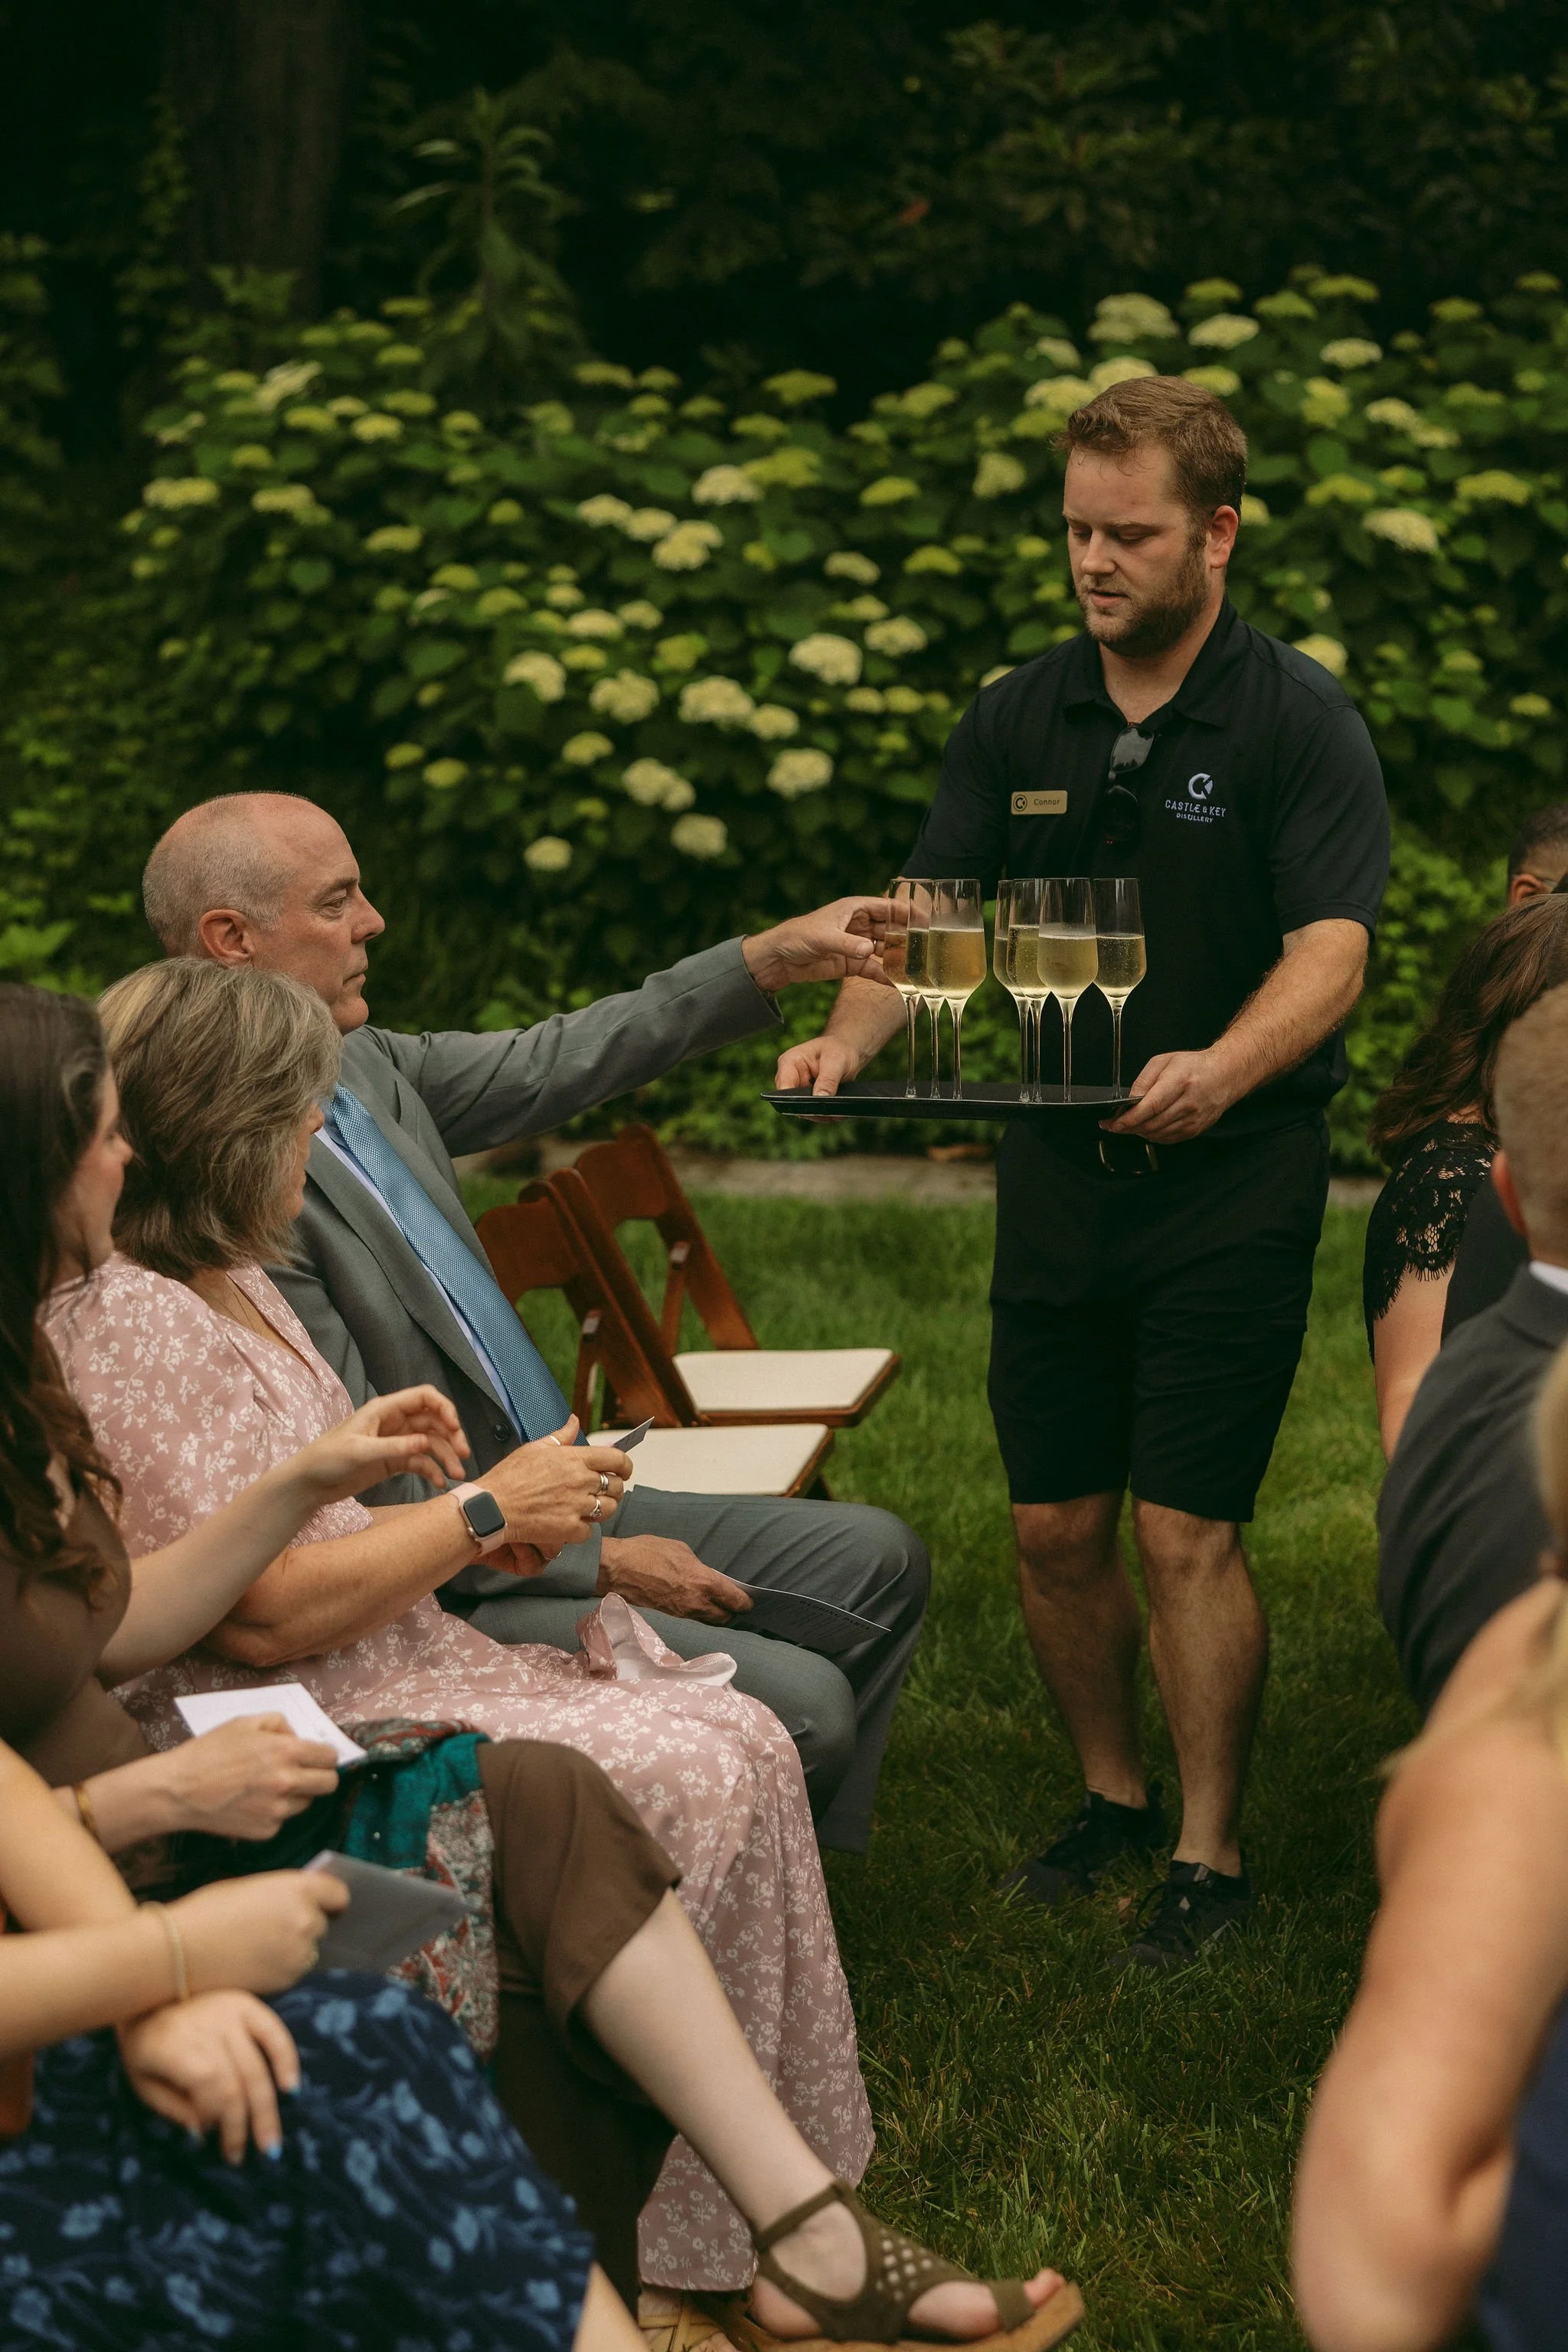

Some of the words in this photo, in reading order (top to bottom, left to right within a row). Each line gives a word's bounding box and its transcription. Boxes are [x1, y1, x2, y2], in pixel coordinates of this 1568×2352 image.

[1165, 799, 1200, 813] CASTLE
[1210, 806, 1226, 817] KEY
[1176, 813, 1214, 823] DISTILLERY
